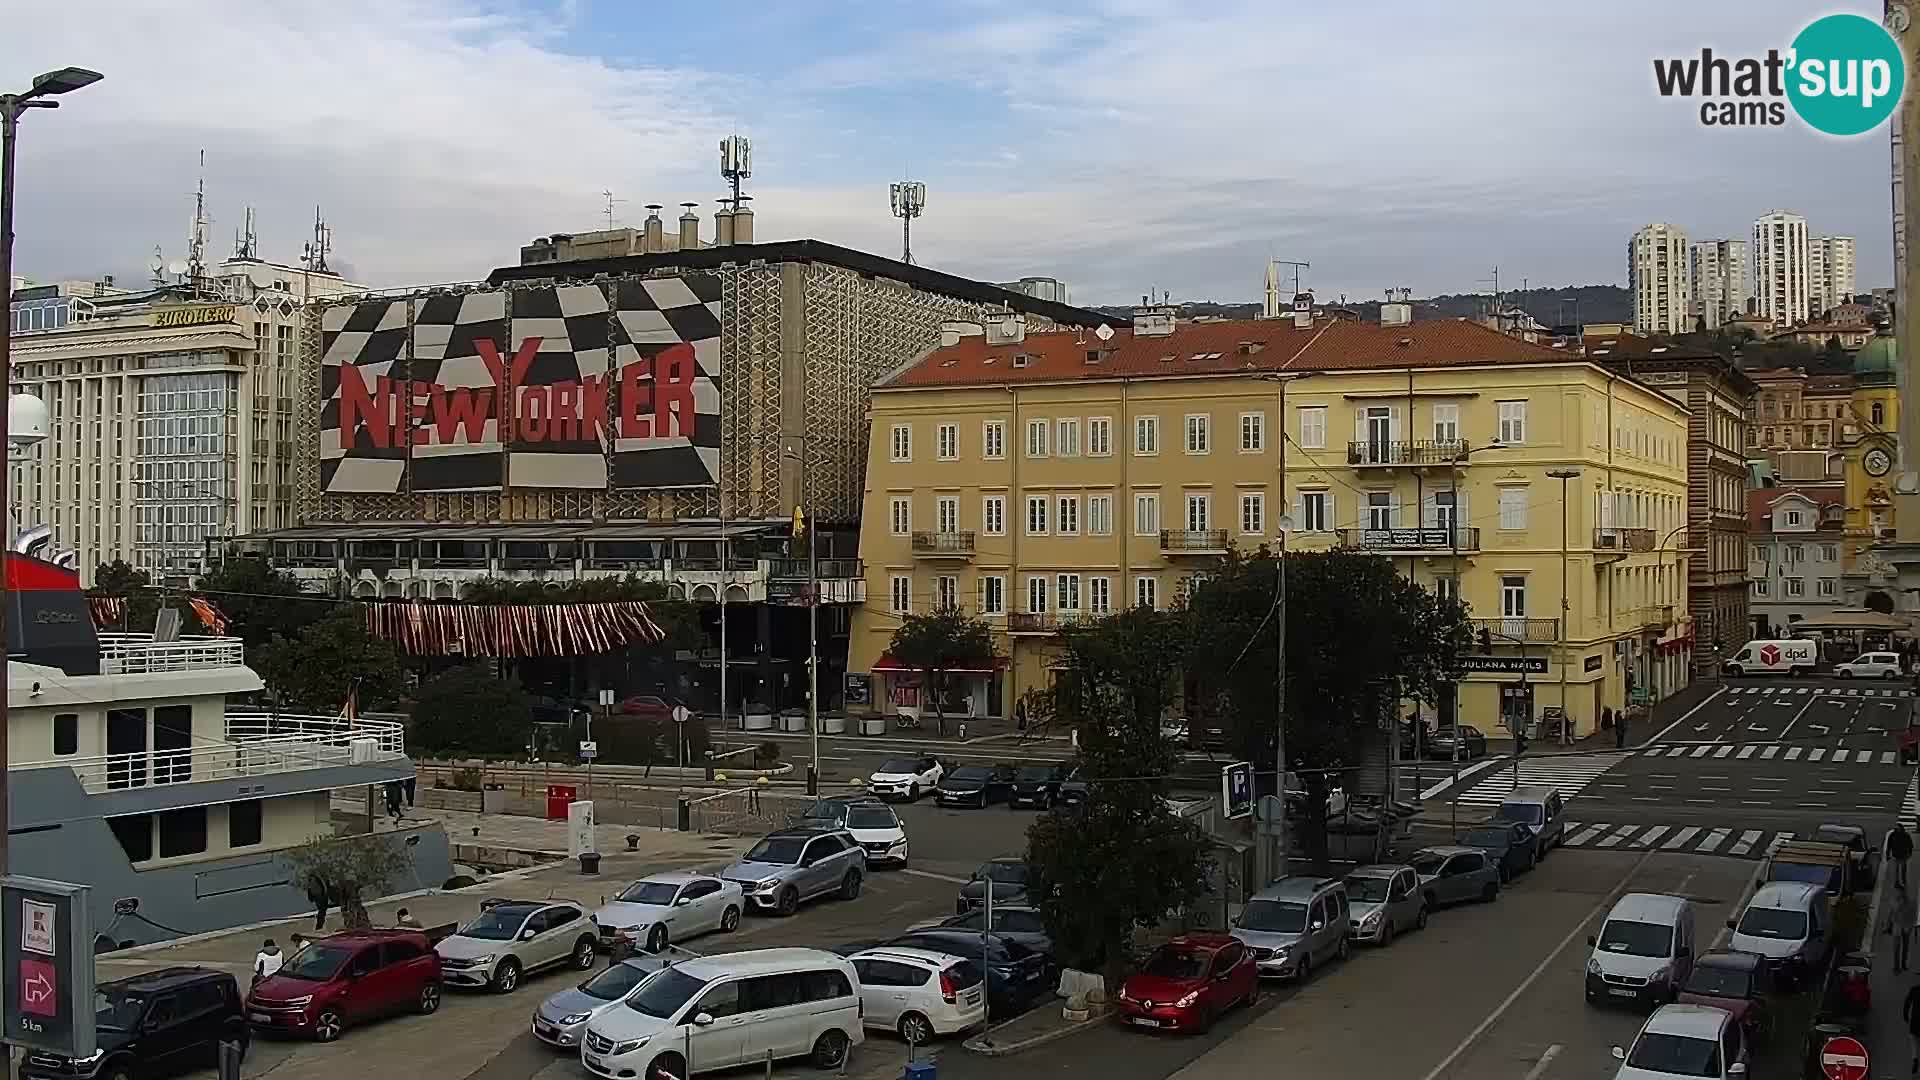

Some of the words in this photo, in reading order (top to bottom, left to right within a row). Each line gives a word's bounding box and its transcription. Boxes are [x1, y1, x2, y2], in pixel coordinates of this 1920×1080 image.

[1785, 648, 1808, 660] dpd
[1460, 660, 1507, 670] JULIANA
[1510, 661, 1543, 670] NAILS
[22, 1018, 28, 1029] 5
[29, 1021, 43, 1033] km
